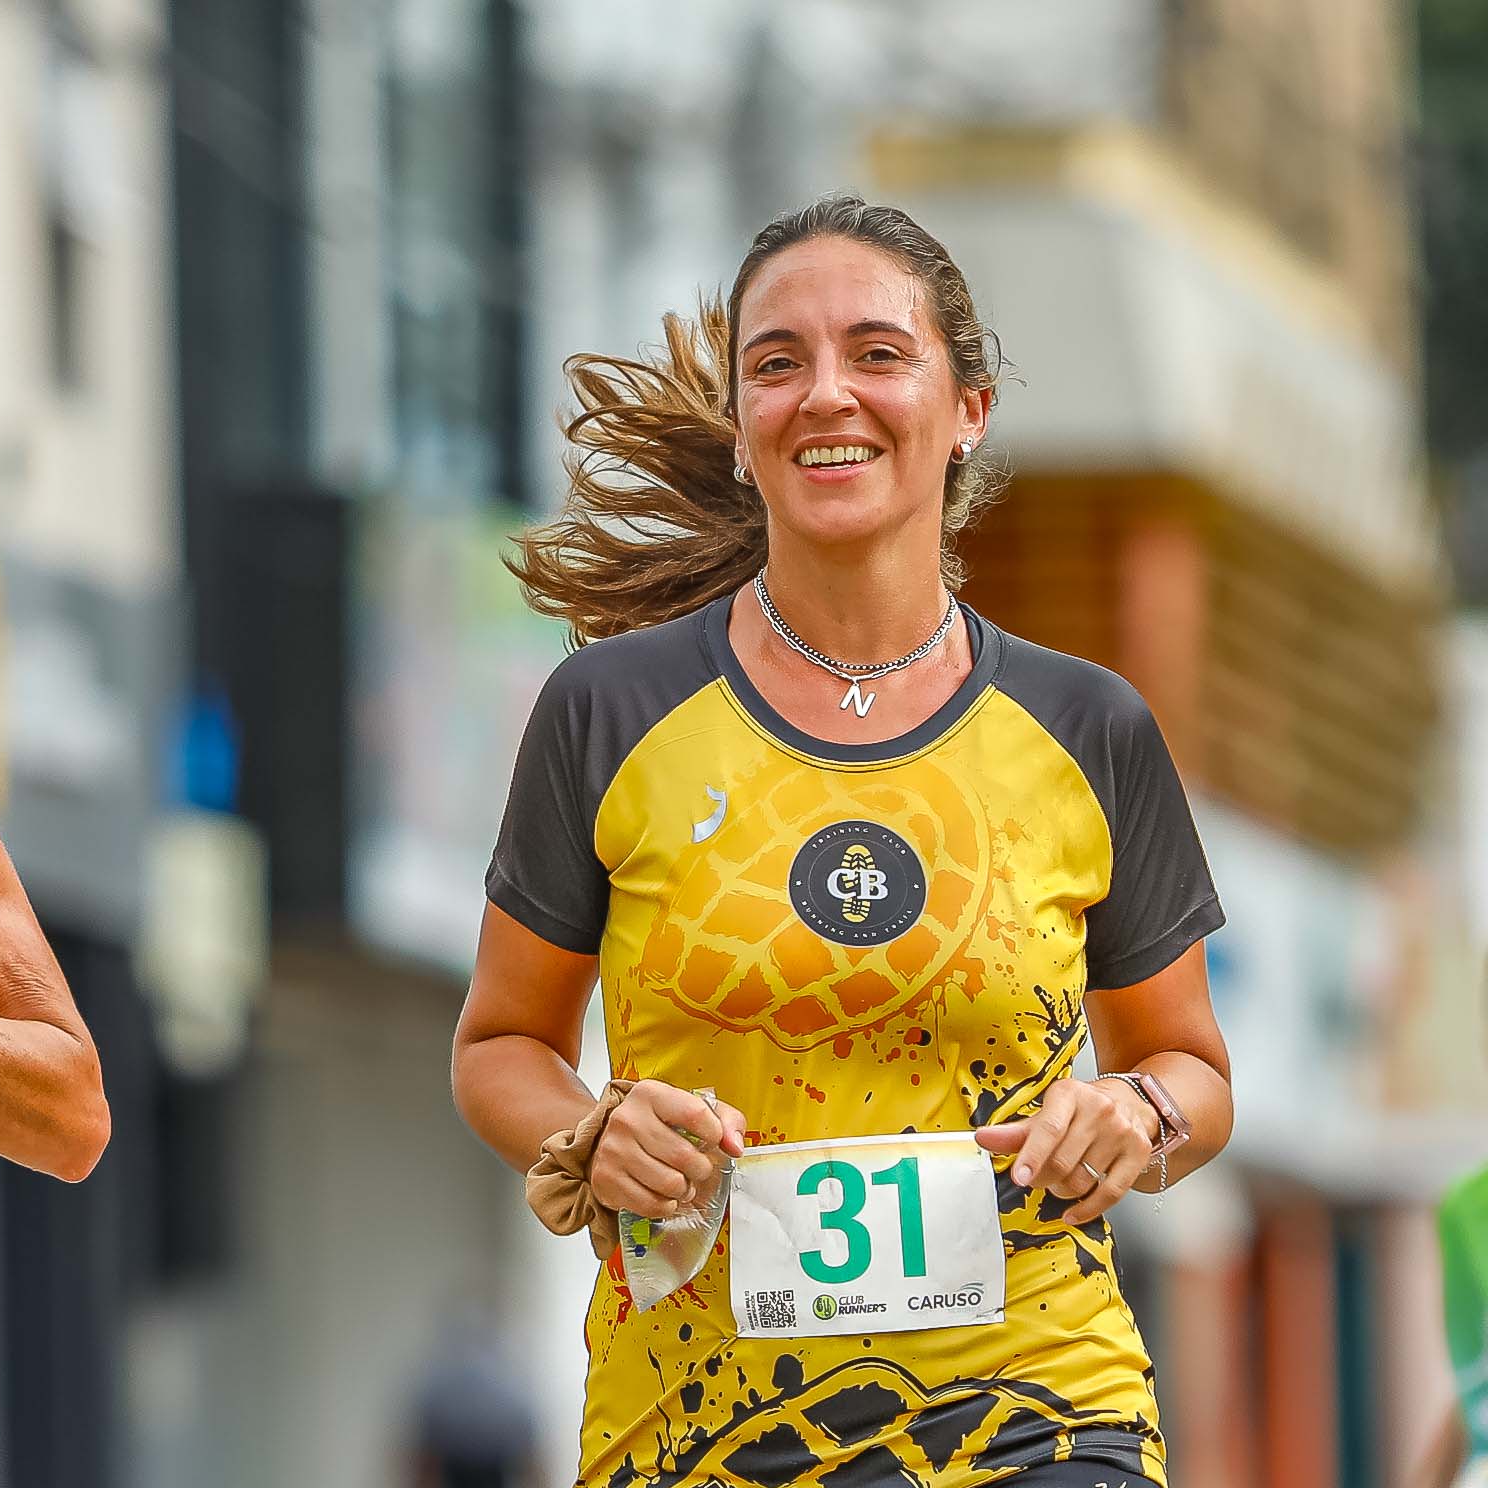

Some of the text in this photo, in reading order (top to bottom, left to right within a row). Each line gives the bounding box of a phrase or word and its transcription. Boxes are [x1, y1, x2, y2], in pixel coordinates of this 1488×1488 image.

[826, 868, 889, 900] CB
[796, 1156, 927, 1285] 31
[838, 1295, 865, 1305] CLUB
[838, 1303, 887, 1316] RUNNER'S
[907, 1291, 982, 1311] CARUSO
